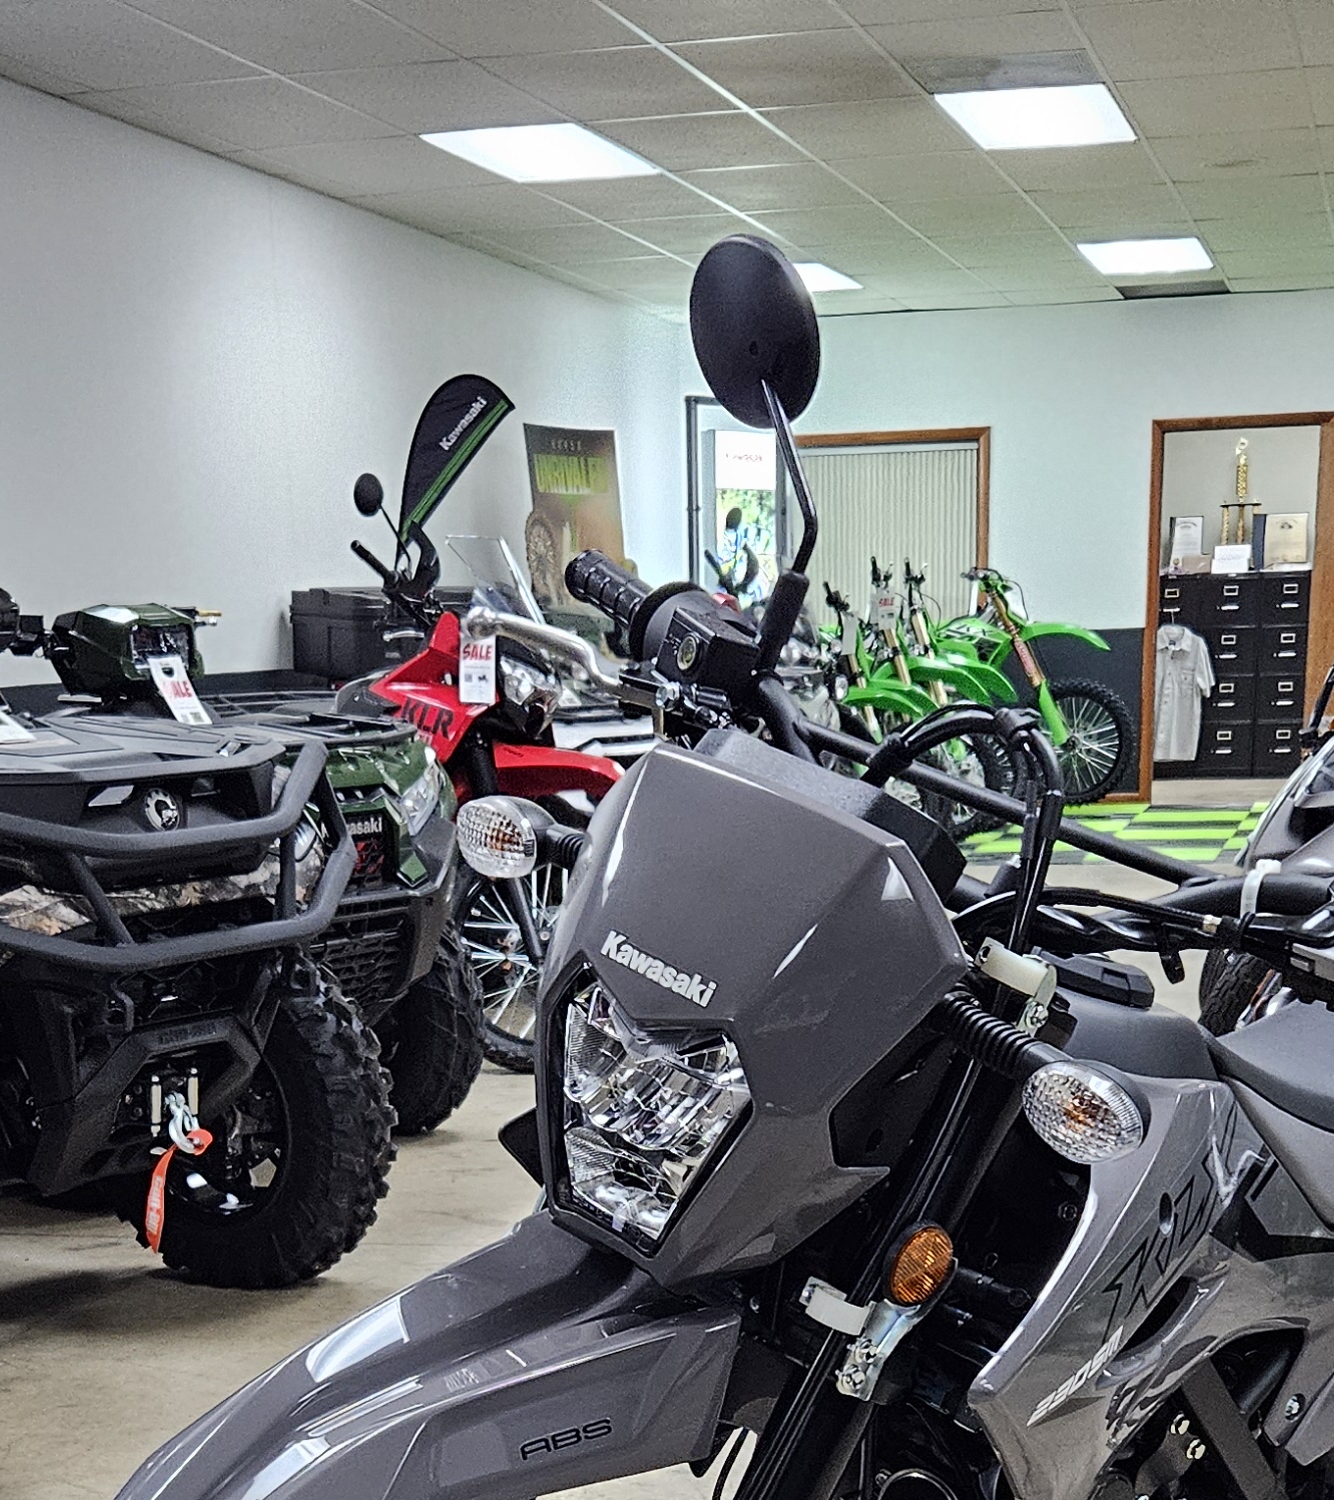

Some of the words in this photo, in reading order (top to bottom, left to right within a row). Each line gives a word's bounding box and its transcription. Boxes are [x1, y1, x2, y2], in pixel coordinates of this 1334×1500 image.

[439, 396, 487, 450] Kawasaki
[463, 643, 493, 660] SALE
[401, 698, 454, 739] KLR
[600, 930, 717, 1008] Kawasaki
[1026, 1325, 1124, 1427] 230SM
[520, 1418, 612, 1461] ABS
